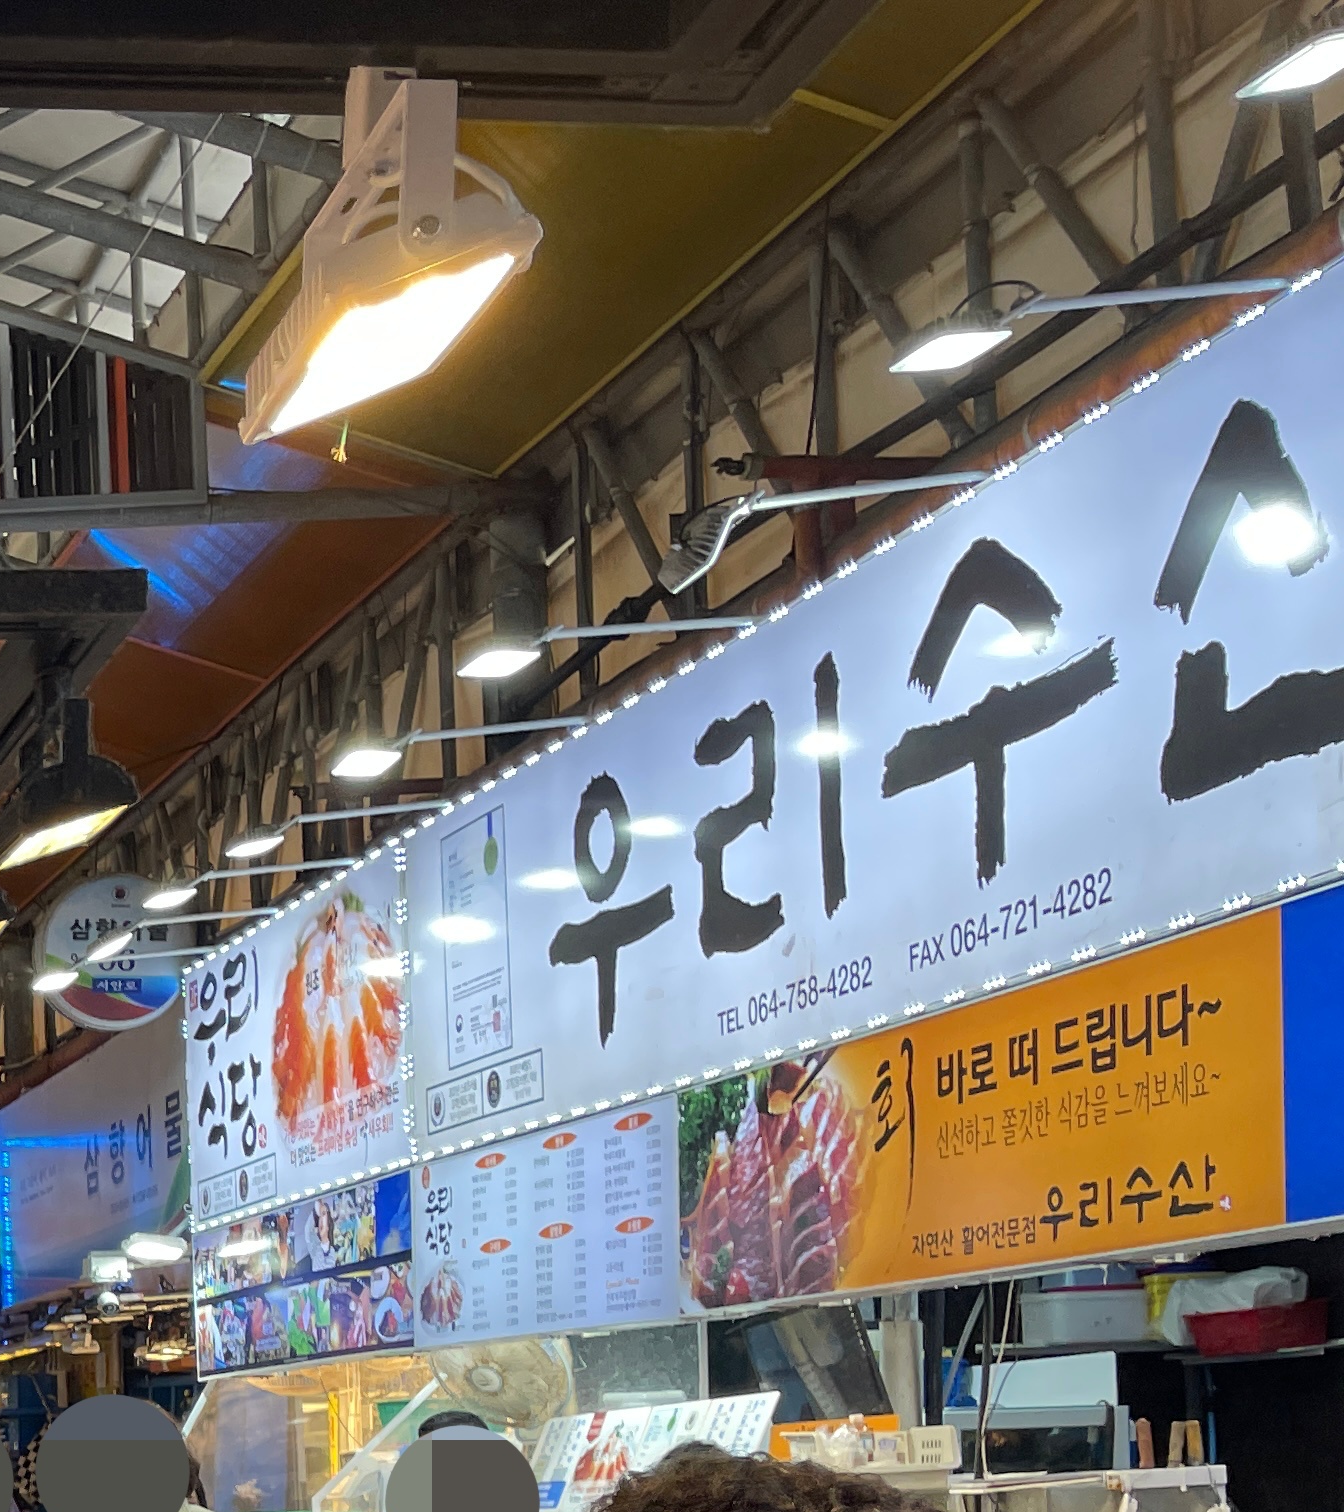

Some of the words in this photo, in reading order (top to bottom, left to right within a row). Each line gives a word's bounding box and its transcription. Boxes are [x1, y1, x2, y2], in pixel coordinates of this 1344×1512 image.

[908, 937, 945, 974] FAX
[950, 866, 1113, 958] 064-721-4282
[193, 946, 260, 1066] 우리
[717, 1006, 746, 1036] TEL
[748, 955, 875, 1028] 064-758-4282
[197, 1053, 262, 1160] 식당
[936, 1042, 998, 1105] 바로
[1009, 1028, 1039, 1086] 떠
[84, 1090, 183, 1196] 삼향어물
[936, 1114, 997, 1160] 신선하고
[1059, 1085, 1107, 1133] 식감을
[913, 1228, 954, 1259] 자연산
[961, 1215, 1036, 1256] 활어전문점
[1039, 1153, 1216, 1242] 우리수산
